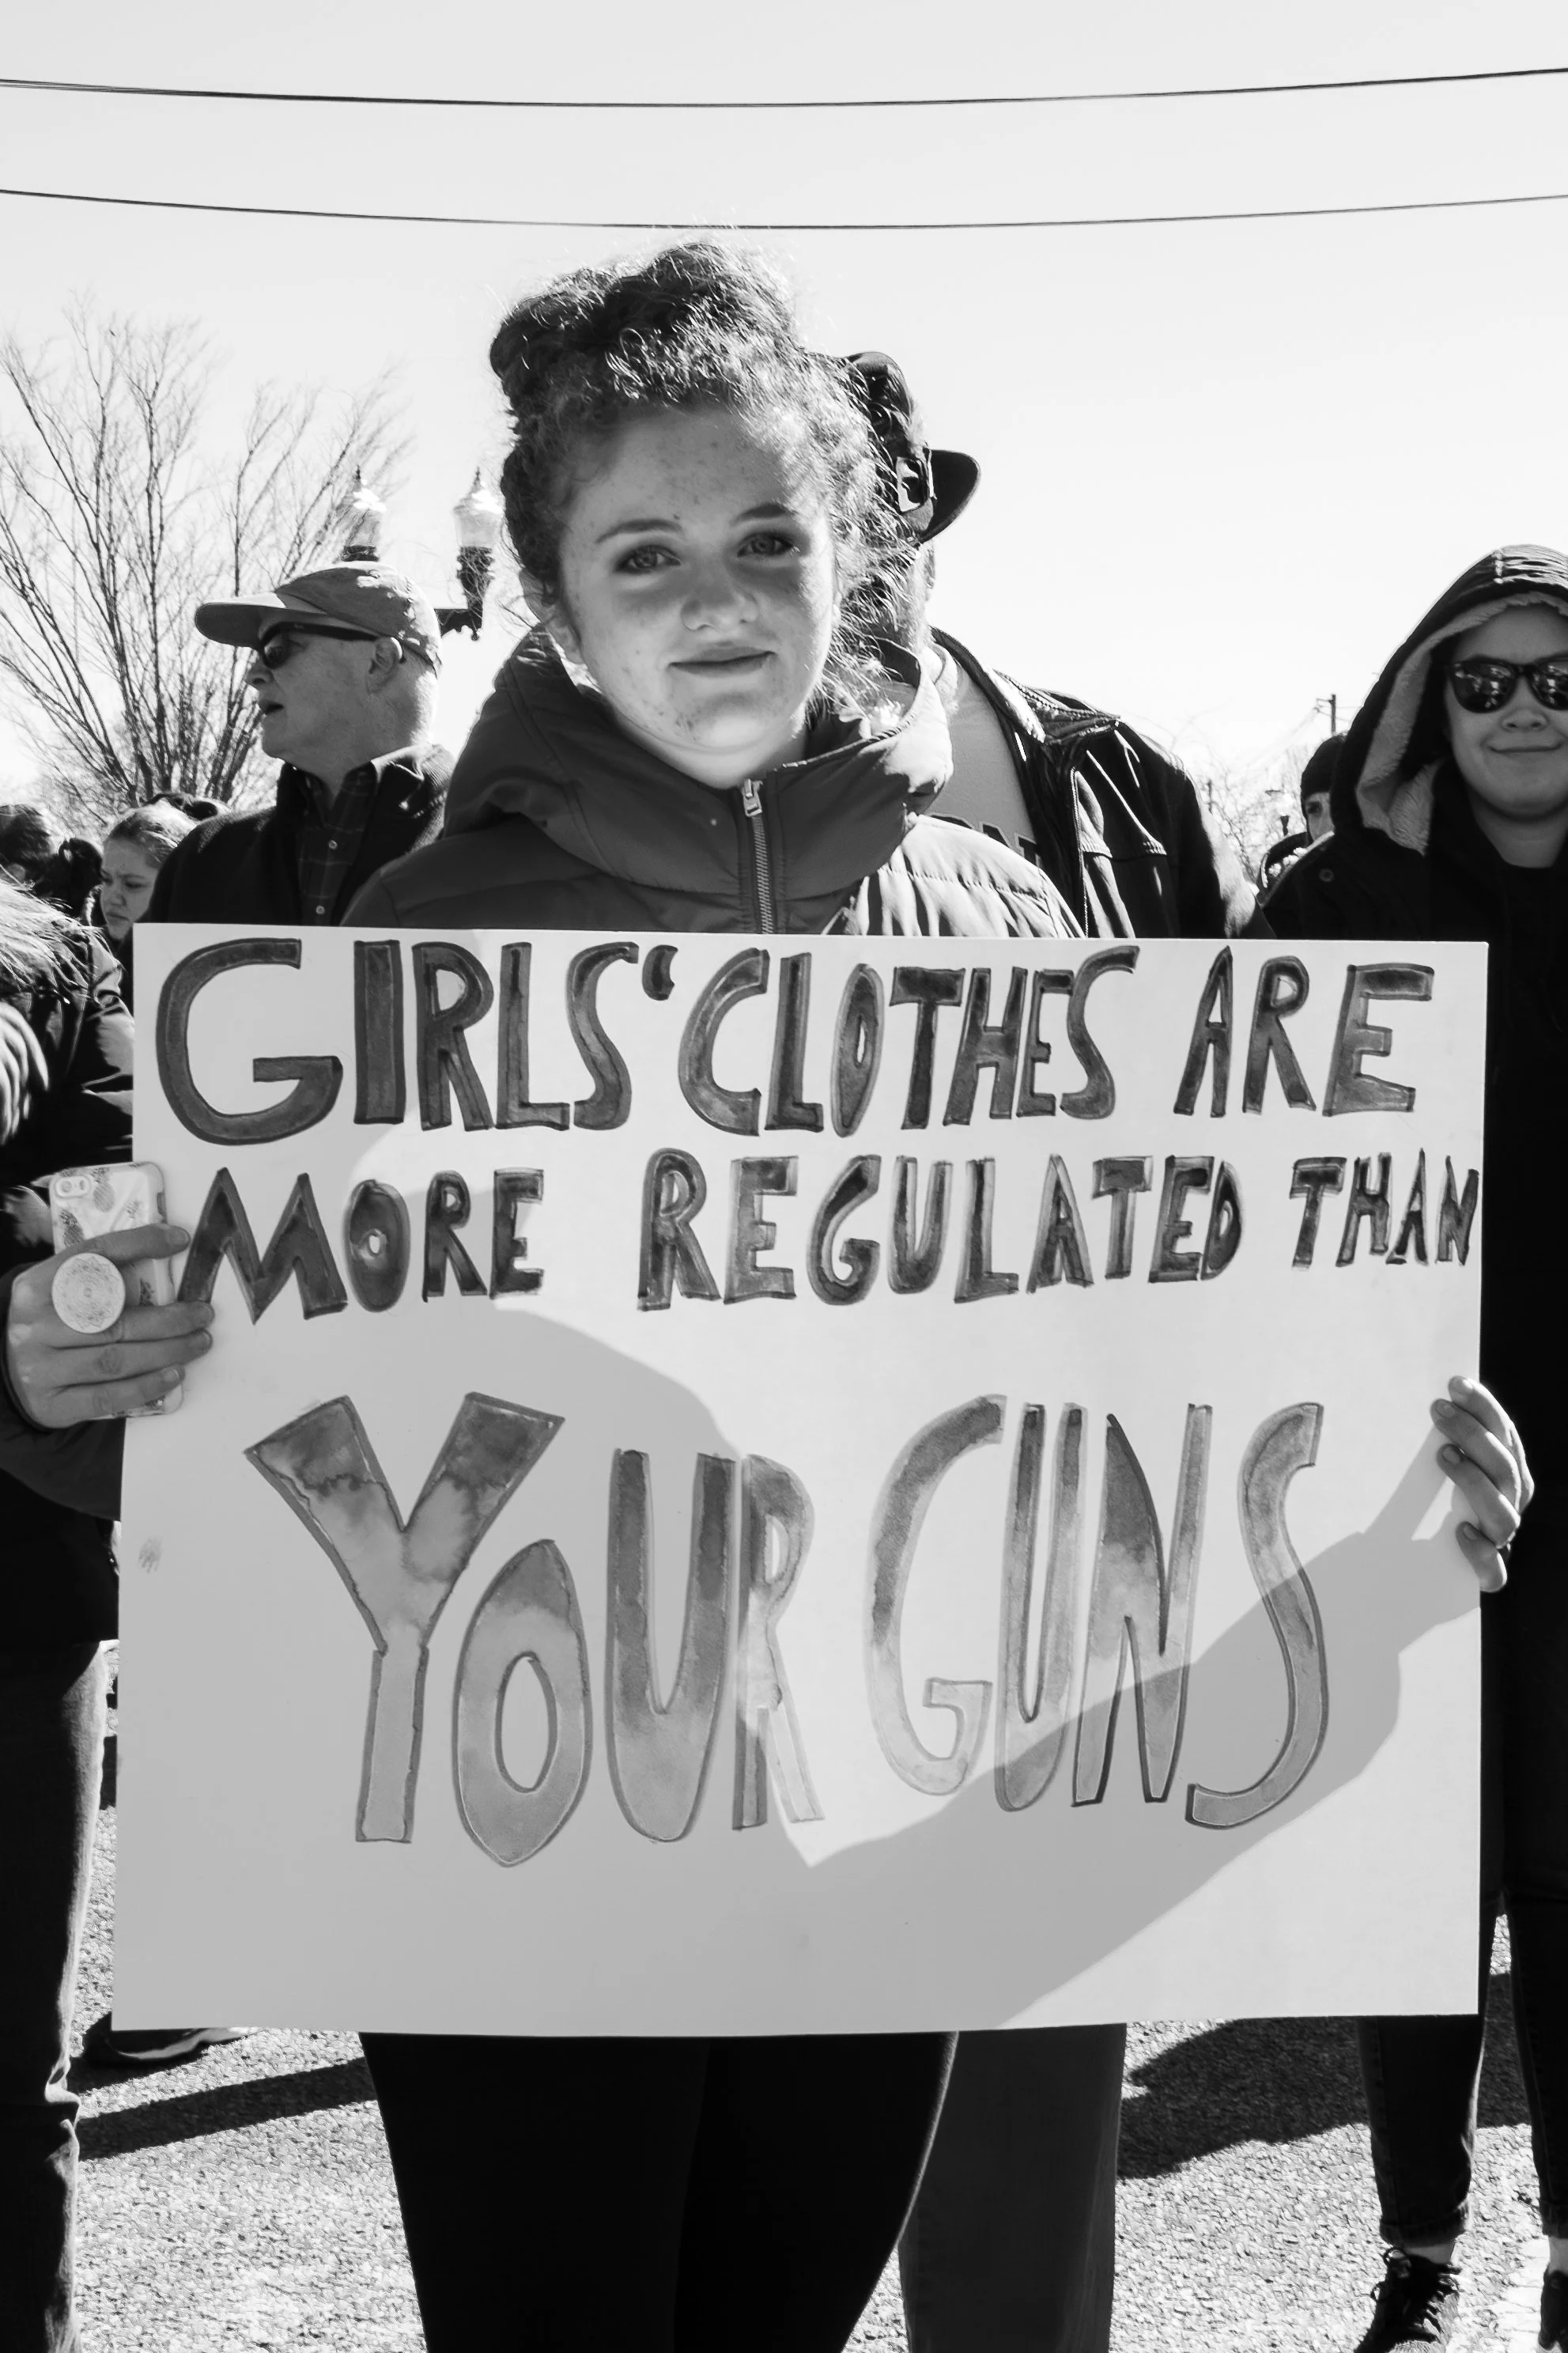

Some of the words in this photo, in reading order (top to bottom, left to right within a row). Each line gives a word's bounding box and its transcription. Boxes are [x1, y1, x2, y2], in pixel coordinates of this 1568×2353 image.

[678, 944, 1140, 1137] CLOTHES
[1173, 945, 1434, 1118] ARE
[177, 1167, 545, 1325] MORE
[637, 1147, 1246, 1313] REGULATED
[1289, 1148, 1480, 1269] THAN
[244, 1390, 825, 1868] YOUR
[862, 1393, 1329, 1829] GUNS
